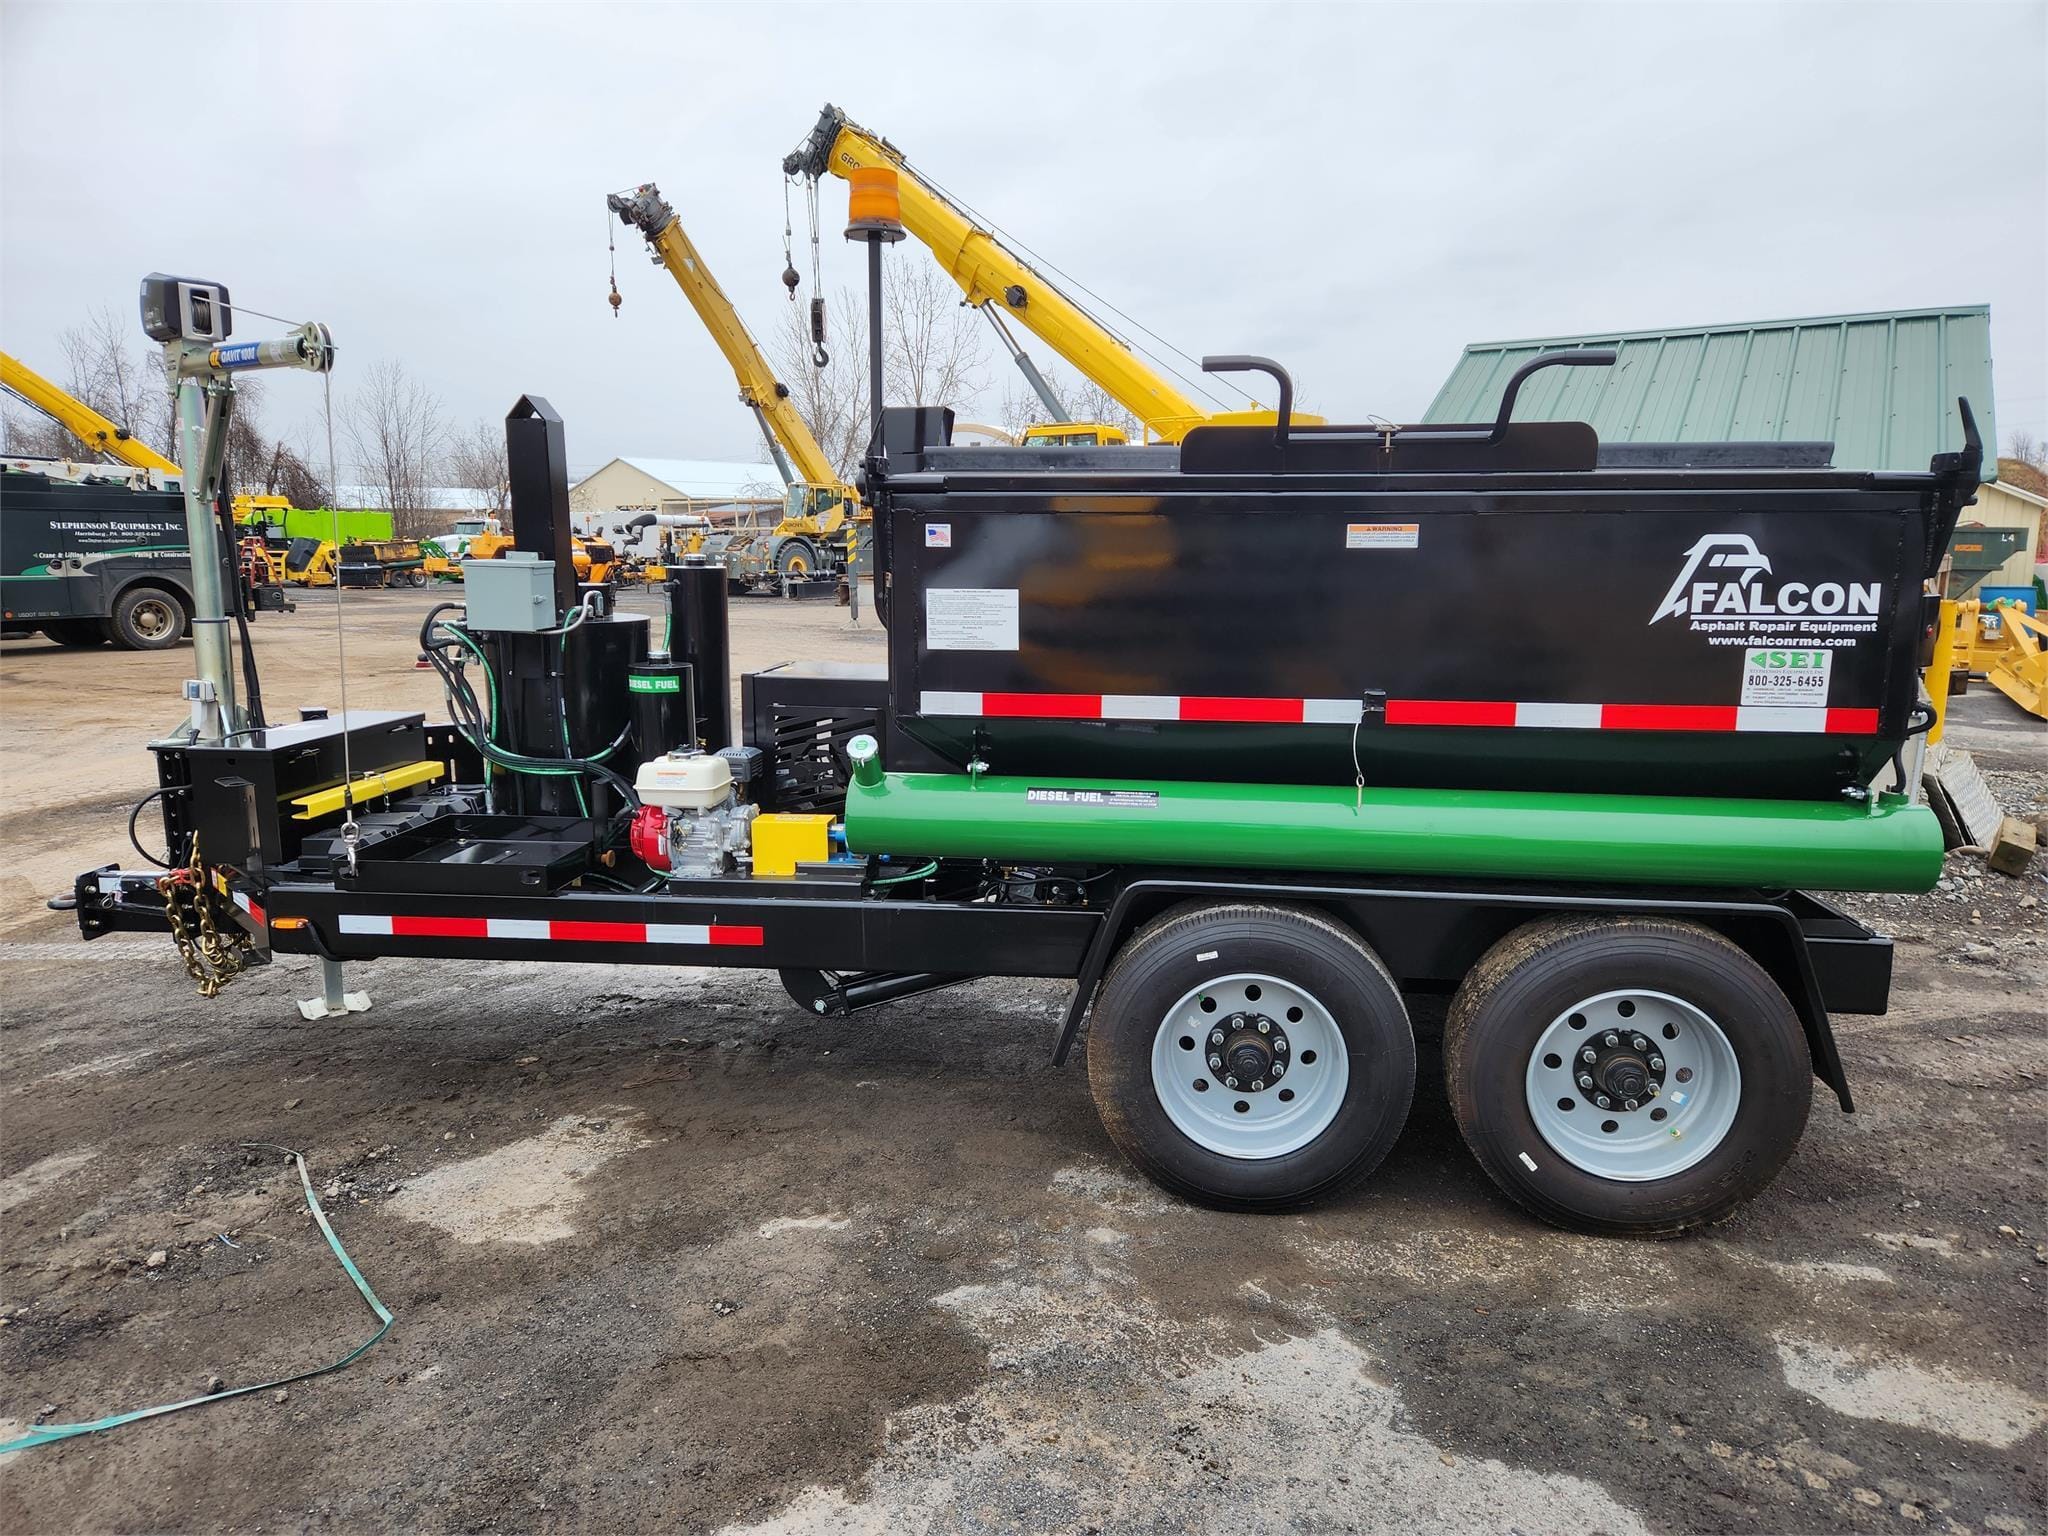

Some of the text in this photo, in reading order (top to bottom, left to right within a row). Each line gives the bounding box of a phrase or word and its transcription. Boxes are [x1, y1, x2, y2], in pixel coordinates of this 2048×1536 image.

[221, 349, 240, 363] DAVIT
[50, 521, 184, 531] STEPHENSON EQUIPMENT, INC.
[64, 551, 84, 559] Lifting
[1690, 582, 1882, 615] FALCON
[1690, 621, 1878, 634] Asphalt Repair Equipment
[1708, 635, 1857, 648] www.falconrme.com
[1768, 651, 1826, 669] SEI
[655, 680, 679, 690] FUEL
[1748, 675, 1825, 688] 800-325-6455
[1027, 790, 1070, 802] DIESEL
[1074, 791, 1105, 803] FUEL
